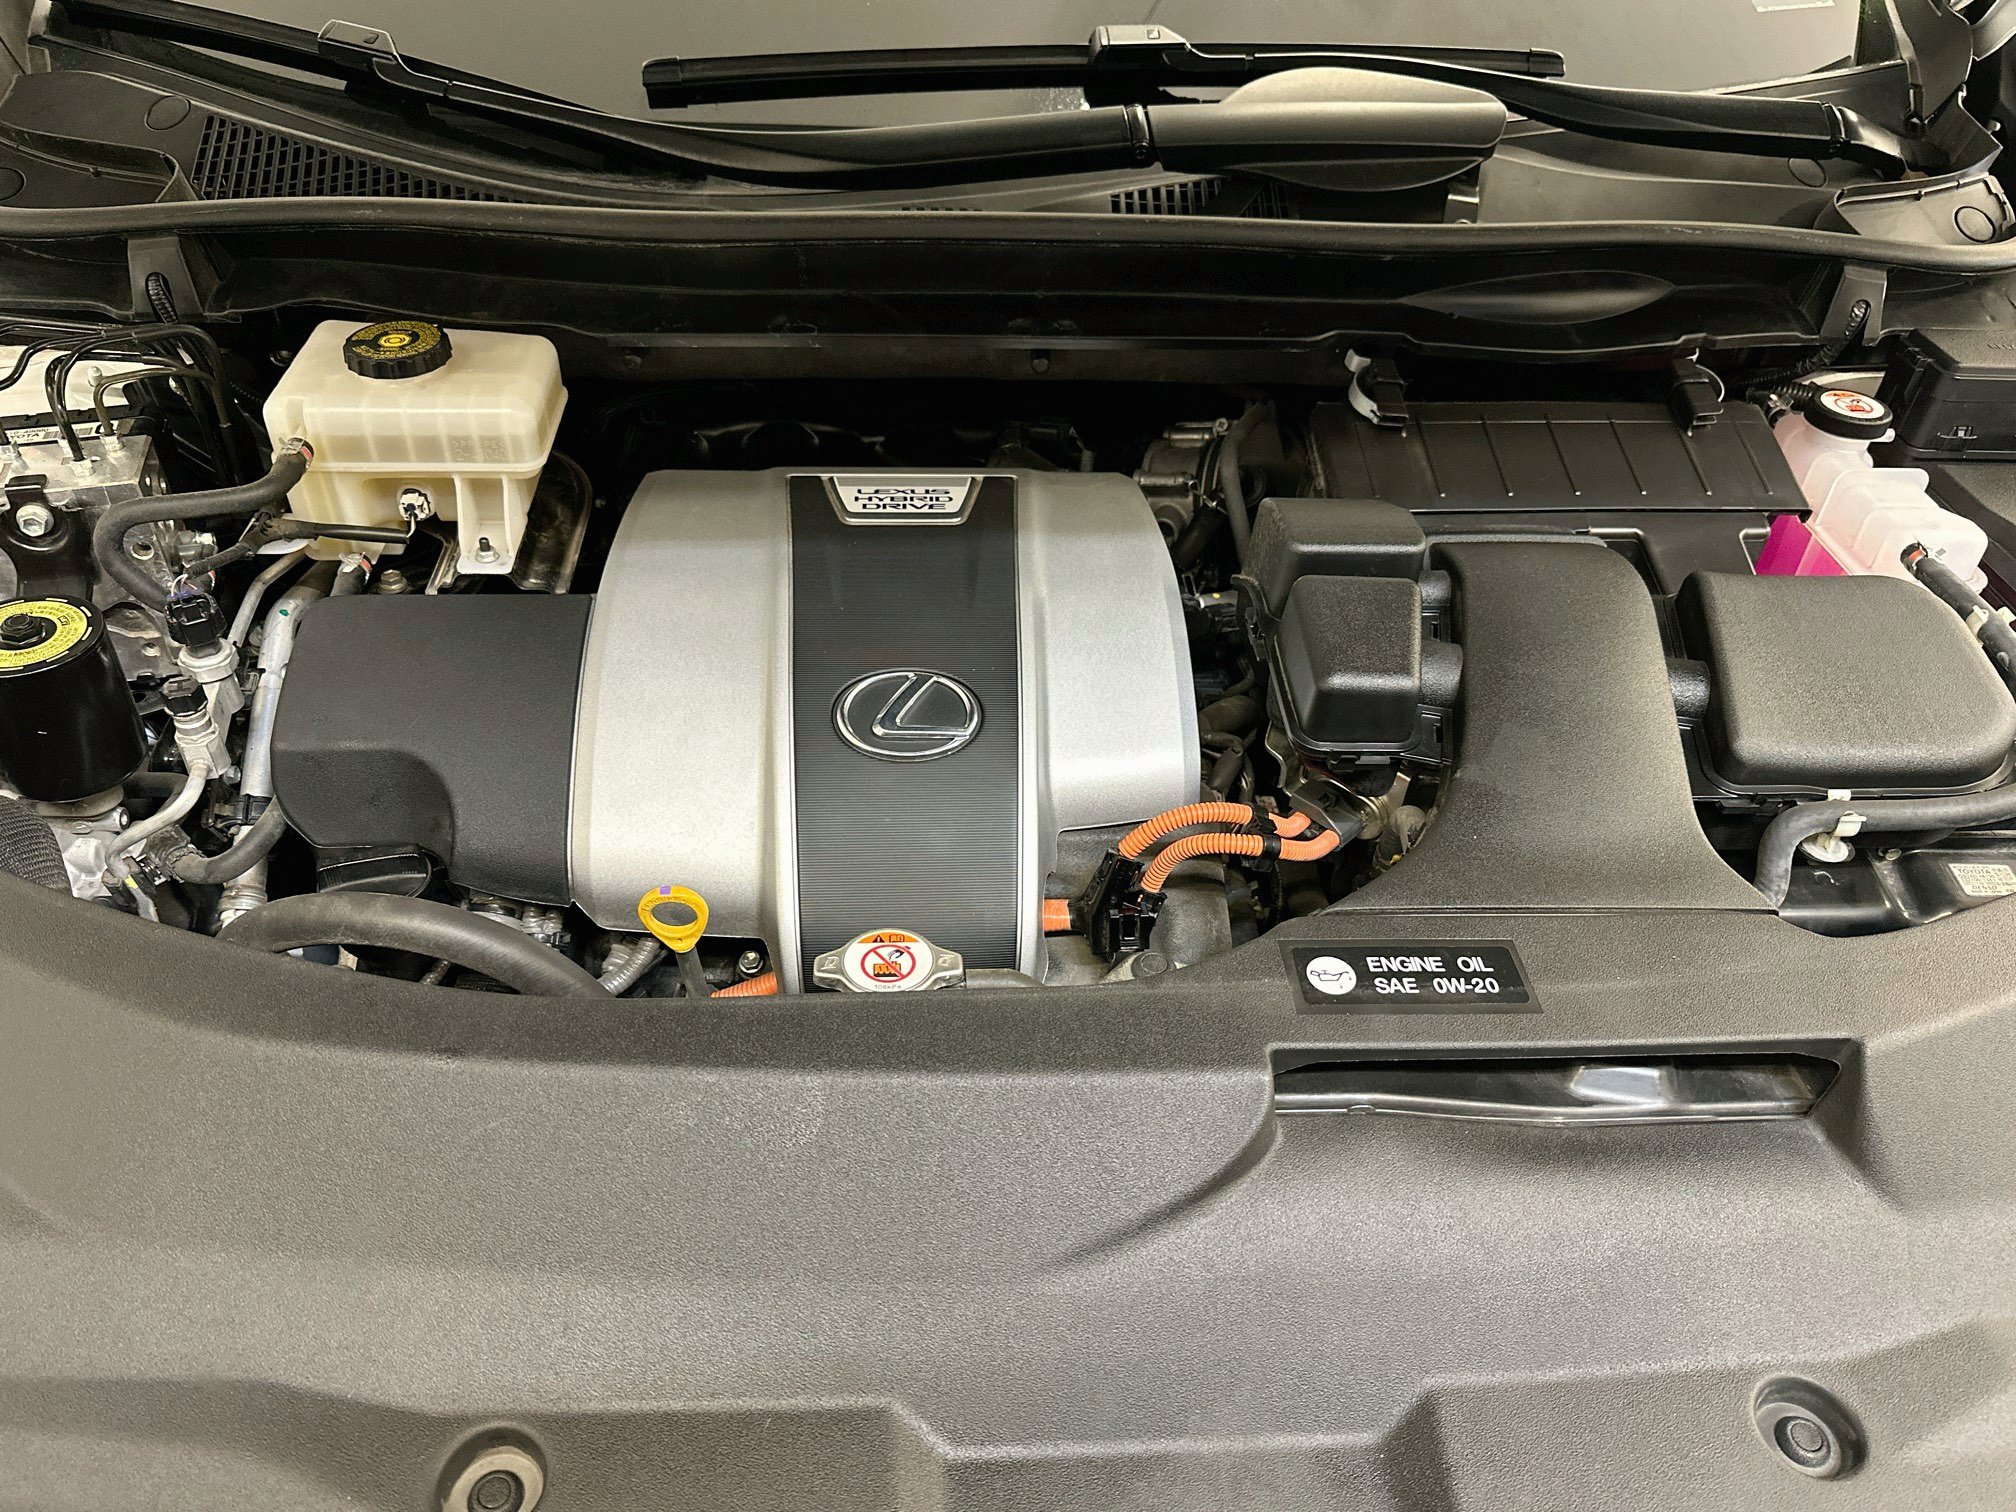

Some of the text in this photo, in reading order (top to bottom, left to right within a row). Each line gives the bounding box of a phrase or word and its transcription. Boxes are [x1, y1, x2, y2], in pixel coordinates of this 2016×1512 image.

[1366, 956, 1494, 973] ENGINE OIL
[1374, 977, 1500, 994] SAE 0W-20
